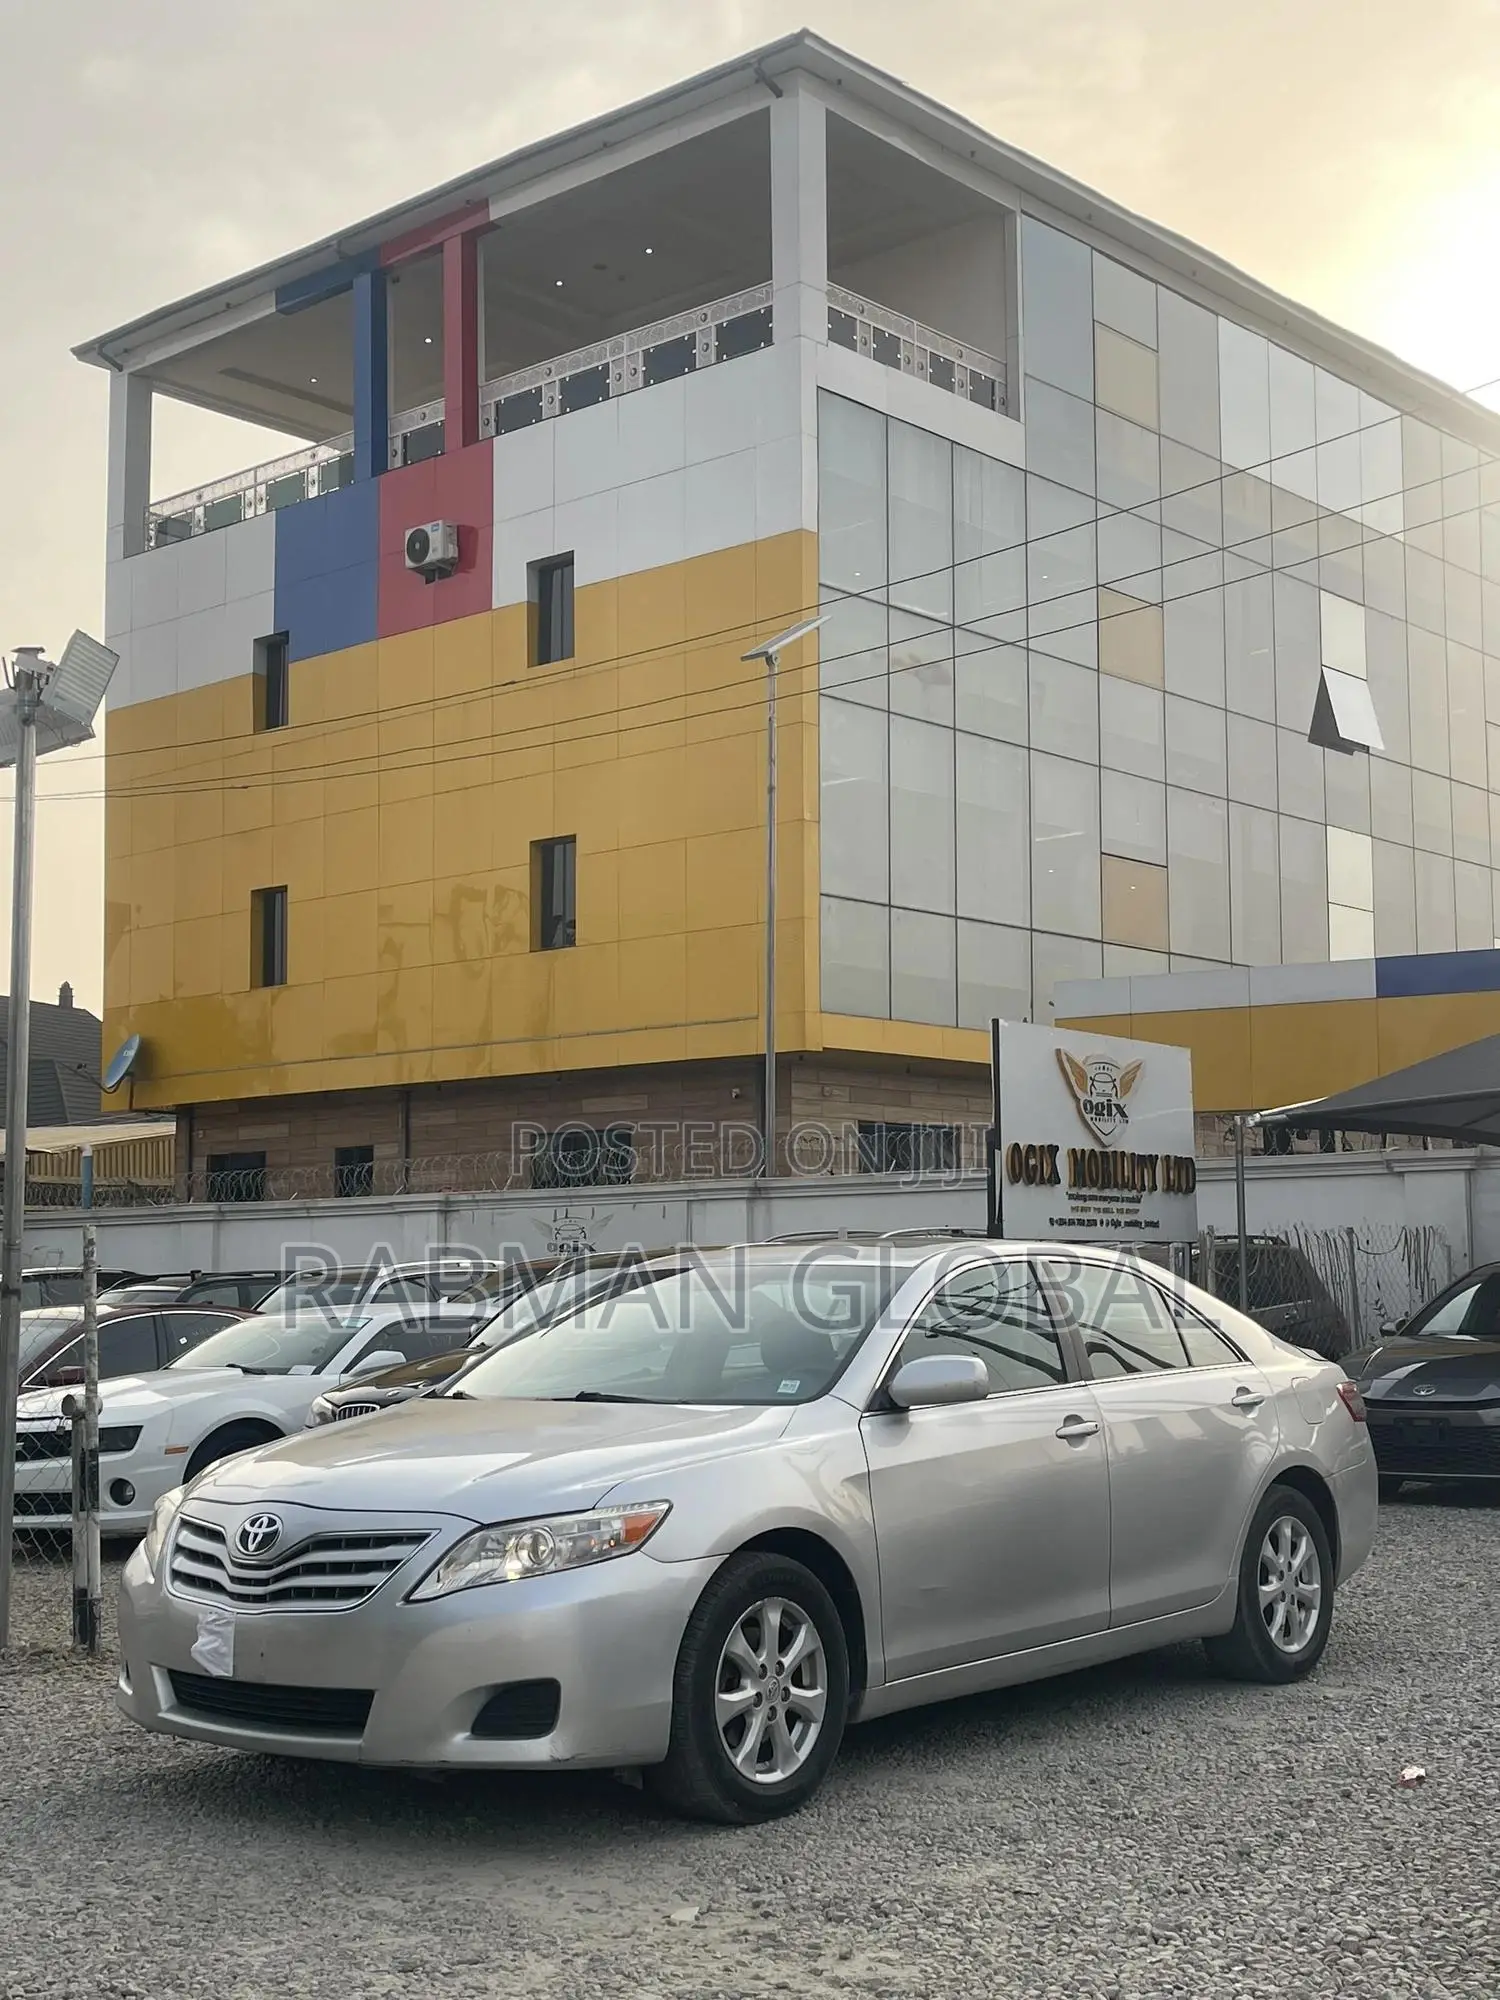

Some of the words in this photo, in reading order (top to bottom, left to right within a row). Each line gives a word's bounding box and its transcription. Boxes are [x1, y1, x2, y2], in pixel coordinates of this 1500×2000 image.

[1006, 1142, 1061, 1185] OGIX
[1067, 1147, 1158, 1193] MOBILITY
[1160, 1154, 1196, 1194] LTD
